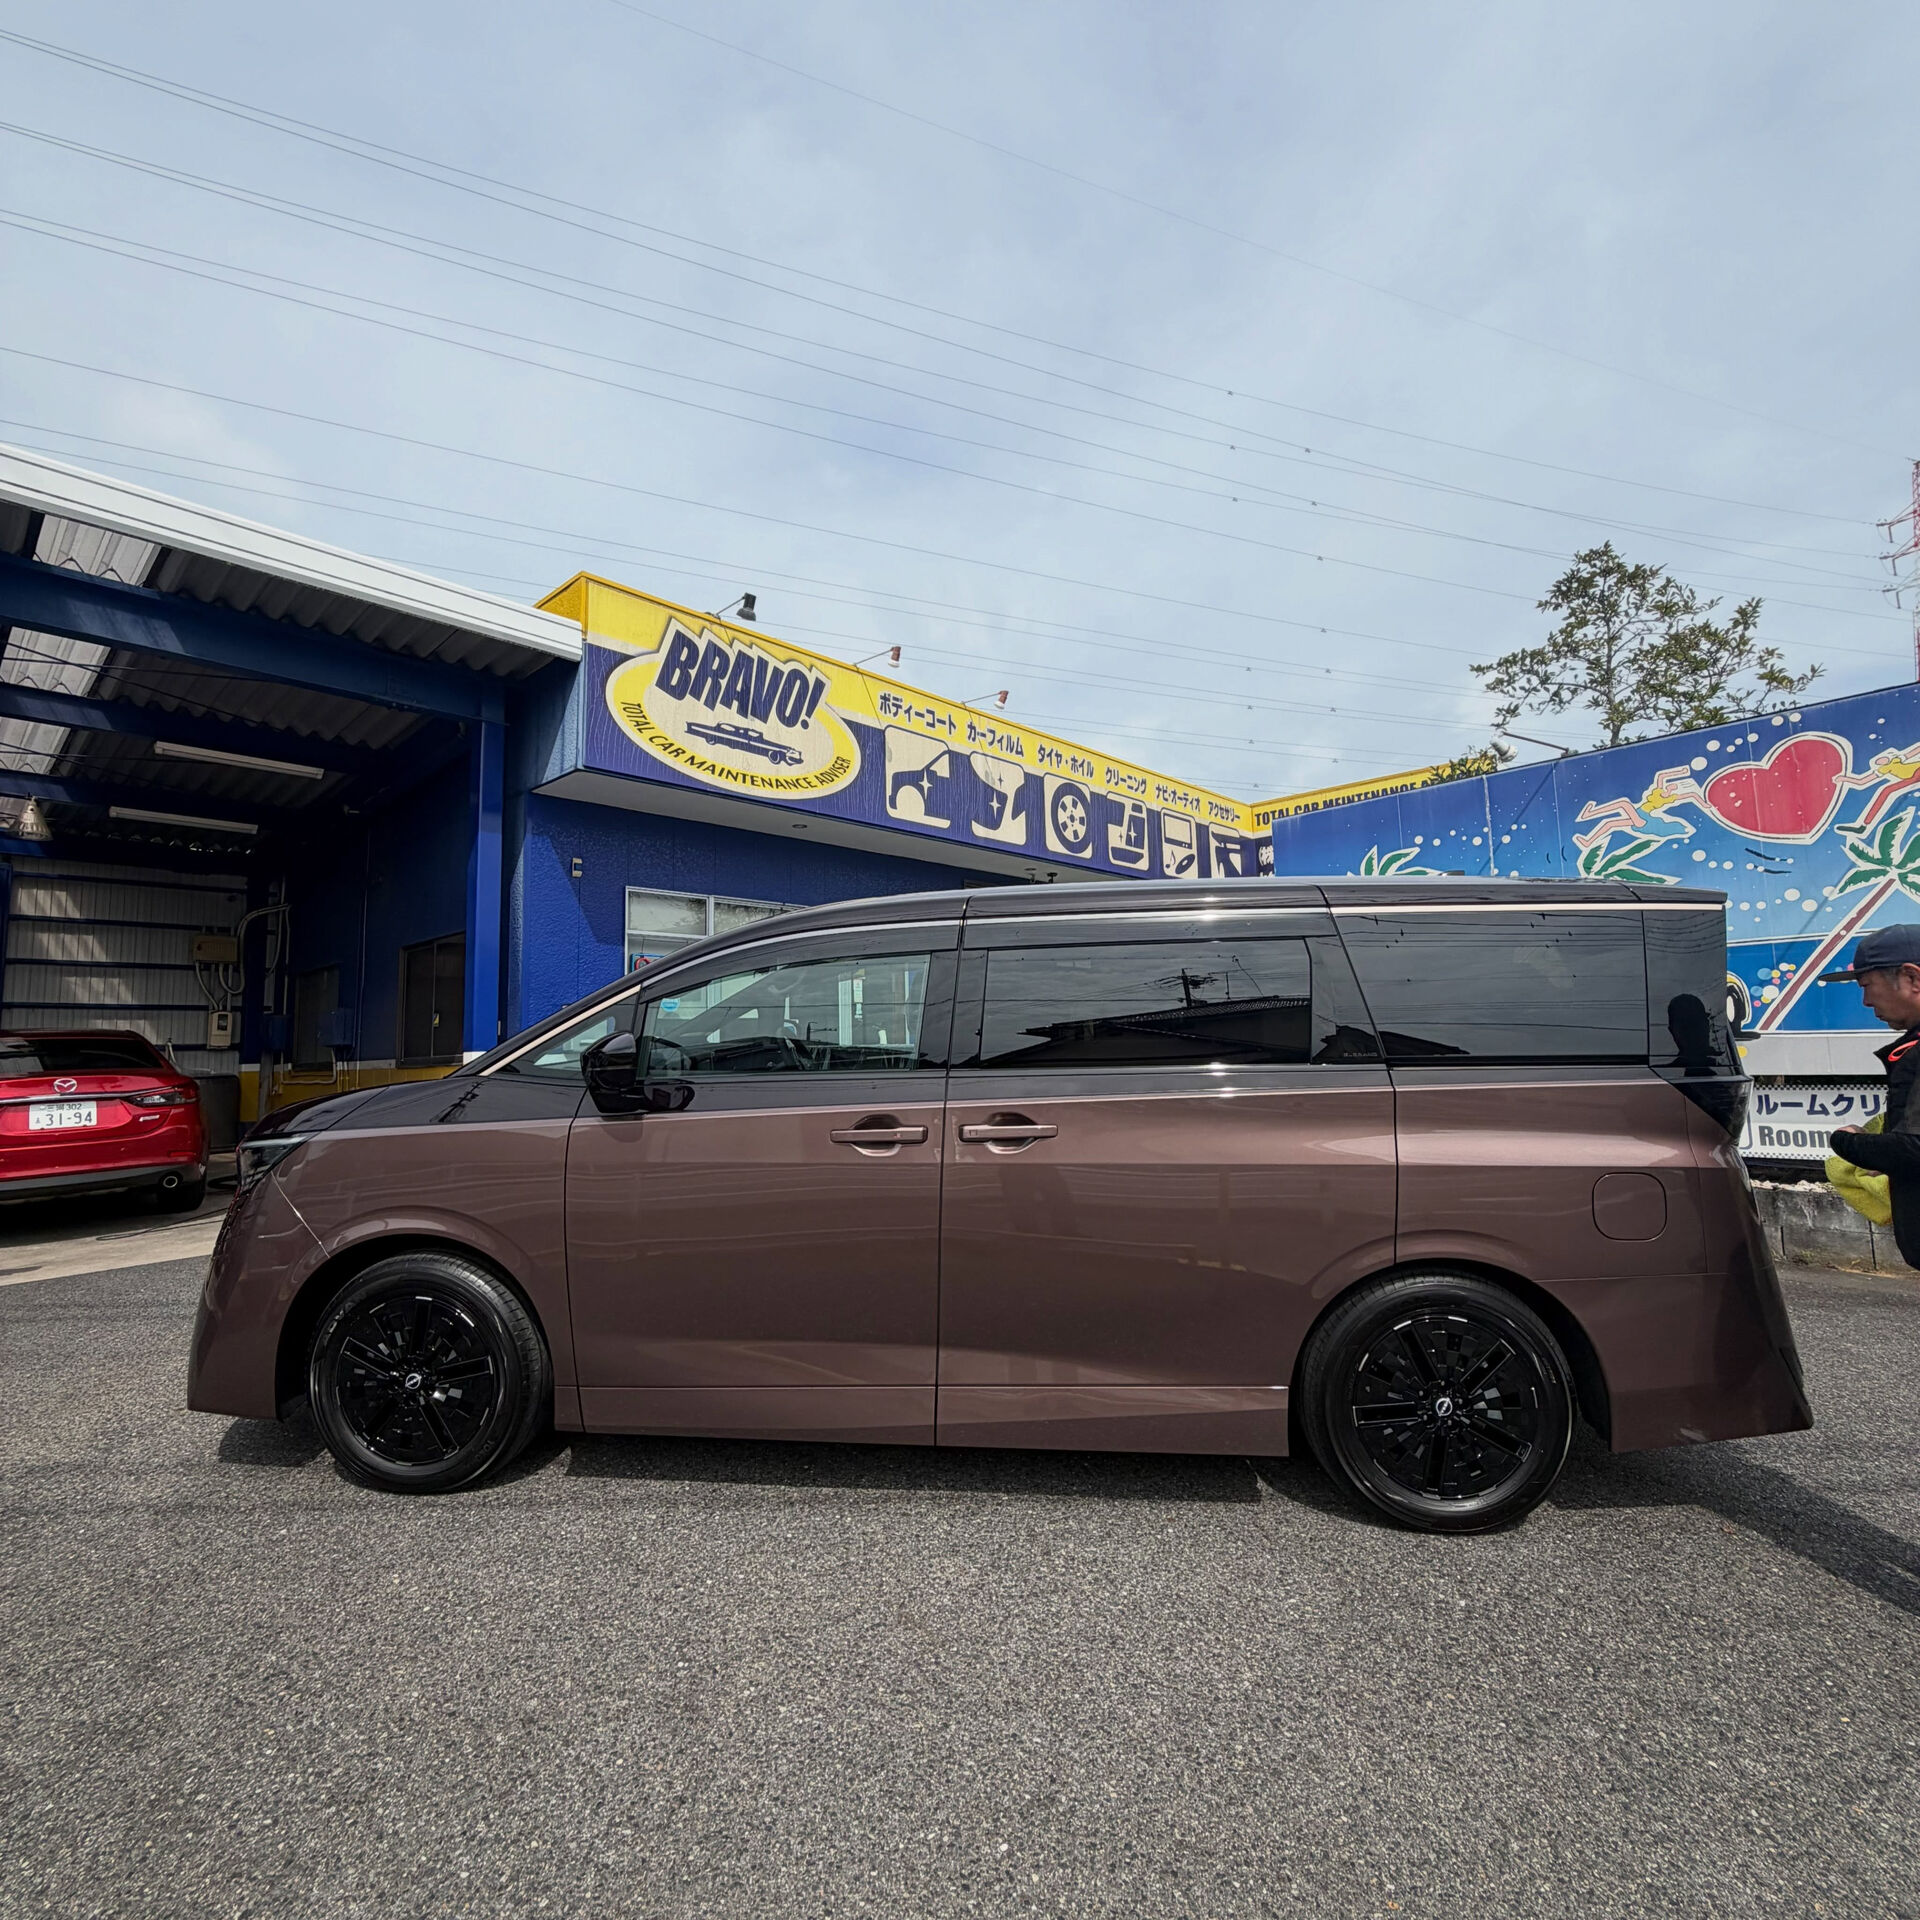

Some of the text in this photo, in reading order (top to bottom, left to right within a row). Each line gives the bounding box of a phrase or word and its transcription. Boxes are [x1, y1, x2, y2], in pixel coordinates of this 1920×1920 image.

[655, 629, 826, 730] BRAVO!
[621, 701, 852, 790] TOTAL CAR MAINTENANCE ADVISER
[879, 693, 957, 735] ボディーコート
[967, 721, 1024, 757] カーフィルム
[1105, 766, 1147, 795] クリーニング
[1207, 801, 1240, 823] アクセサリー
[45, 1111, 93, 1127] 31-94
[66, 1103, 82, 1111] 302
